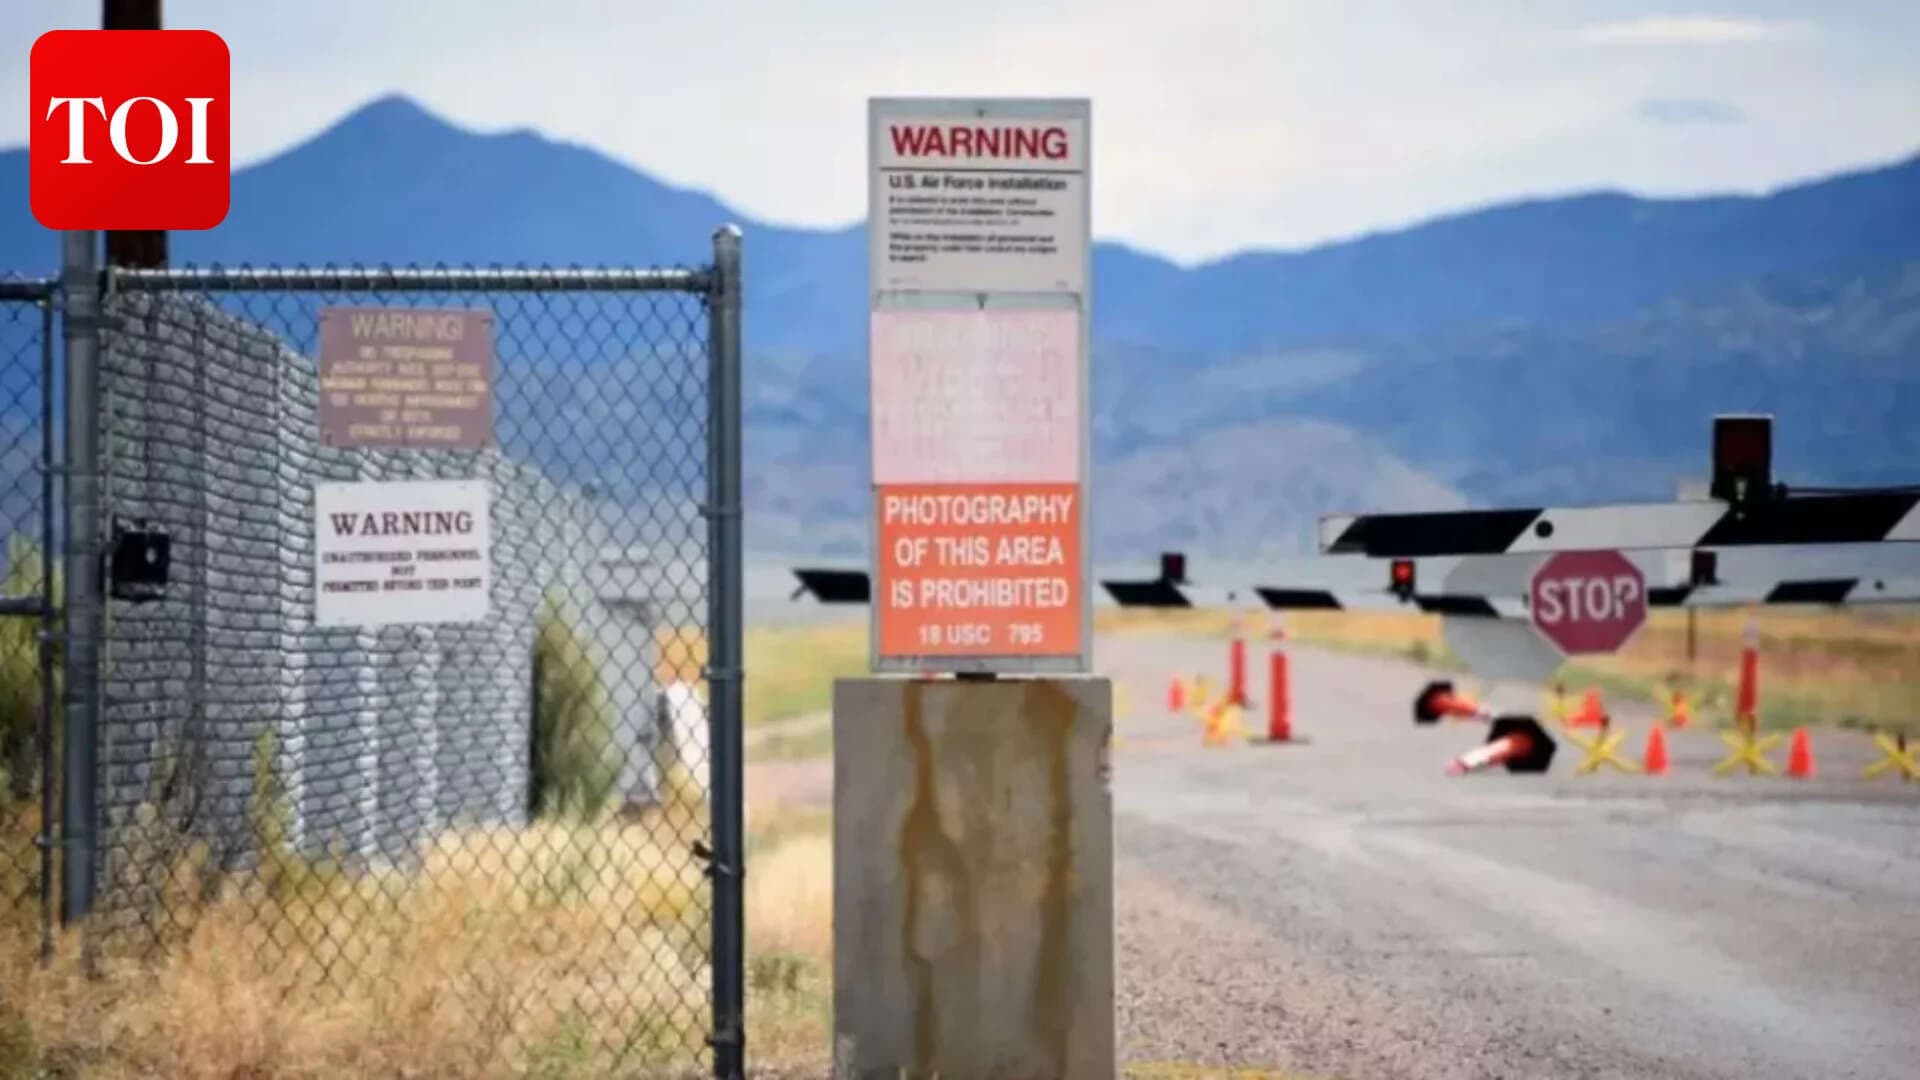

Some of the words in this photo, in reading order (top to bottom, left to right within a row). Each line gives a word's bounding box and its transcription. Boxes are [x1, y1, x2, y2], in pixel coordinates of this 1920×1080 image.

[890, 125, 1069, 158] WARNING
[889, 175, 916, 189] U.S.
[920, 176, 939, 189] Air
[943, 177, 984, 191] Force
[330, 511, 474, 536] WARNING
[885, 494, 1073, 525] PHOTOGRAPHY
[895, 537, 928, 567] OF
[934, 536, 990, 566] THIS
[995, 535, 1064, 565] AREA
[891, 579, 913, 608] IS
[920, 577, 1069, 608] PROHIBITED
[1539, 576, 1639, 623] STOP
[918, 624, 942, 643] 18
[947, 624, 991, 643] USC
